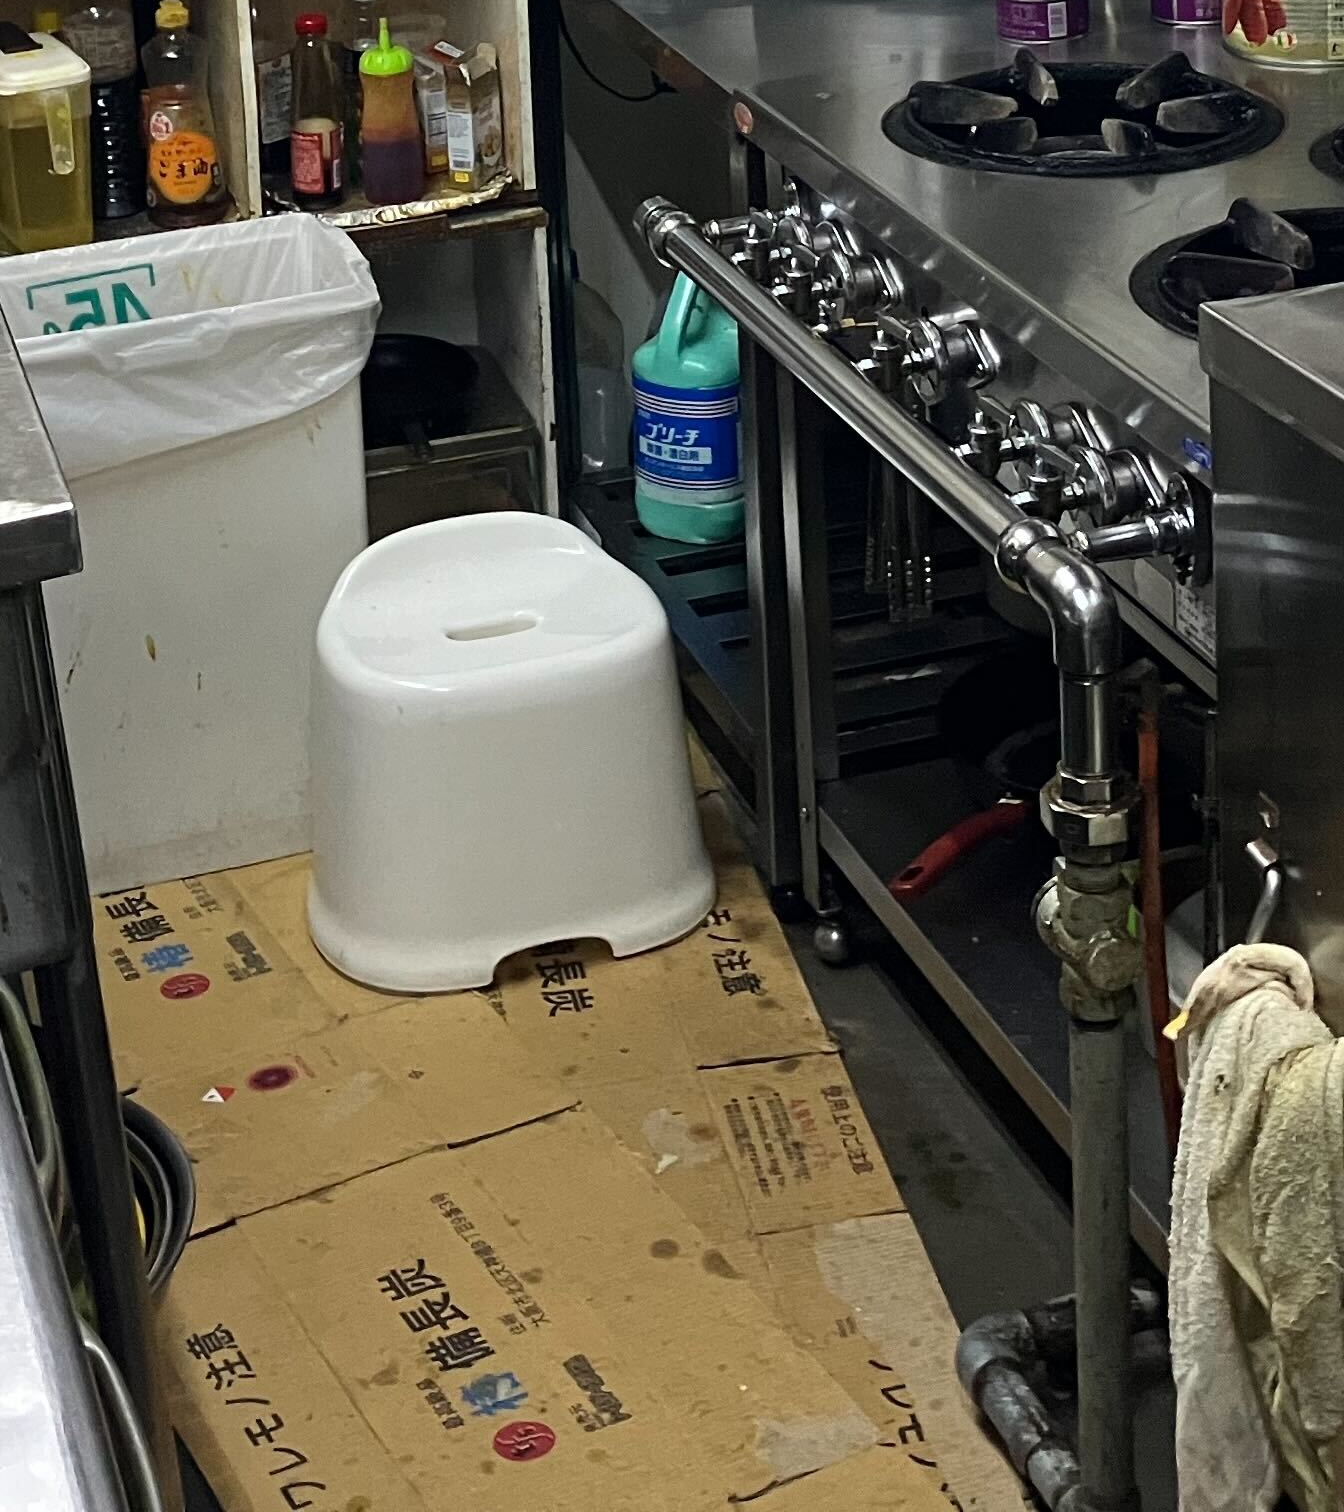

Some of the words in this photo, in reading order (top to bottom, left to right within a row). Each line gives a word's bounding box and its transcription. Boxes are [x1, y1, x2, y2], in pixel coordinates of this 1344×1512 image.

[644, 423, 700, 446] ブリーチ
[99, 885, 175, 944] 備長
[376, 1258, 496, 1372] 備長炭
[185, 1321, 325, 1511] ワレモノ注意
